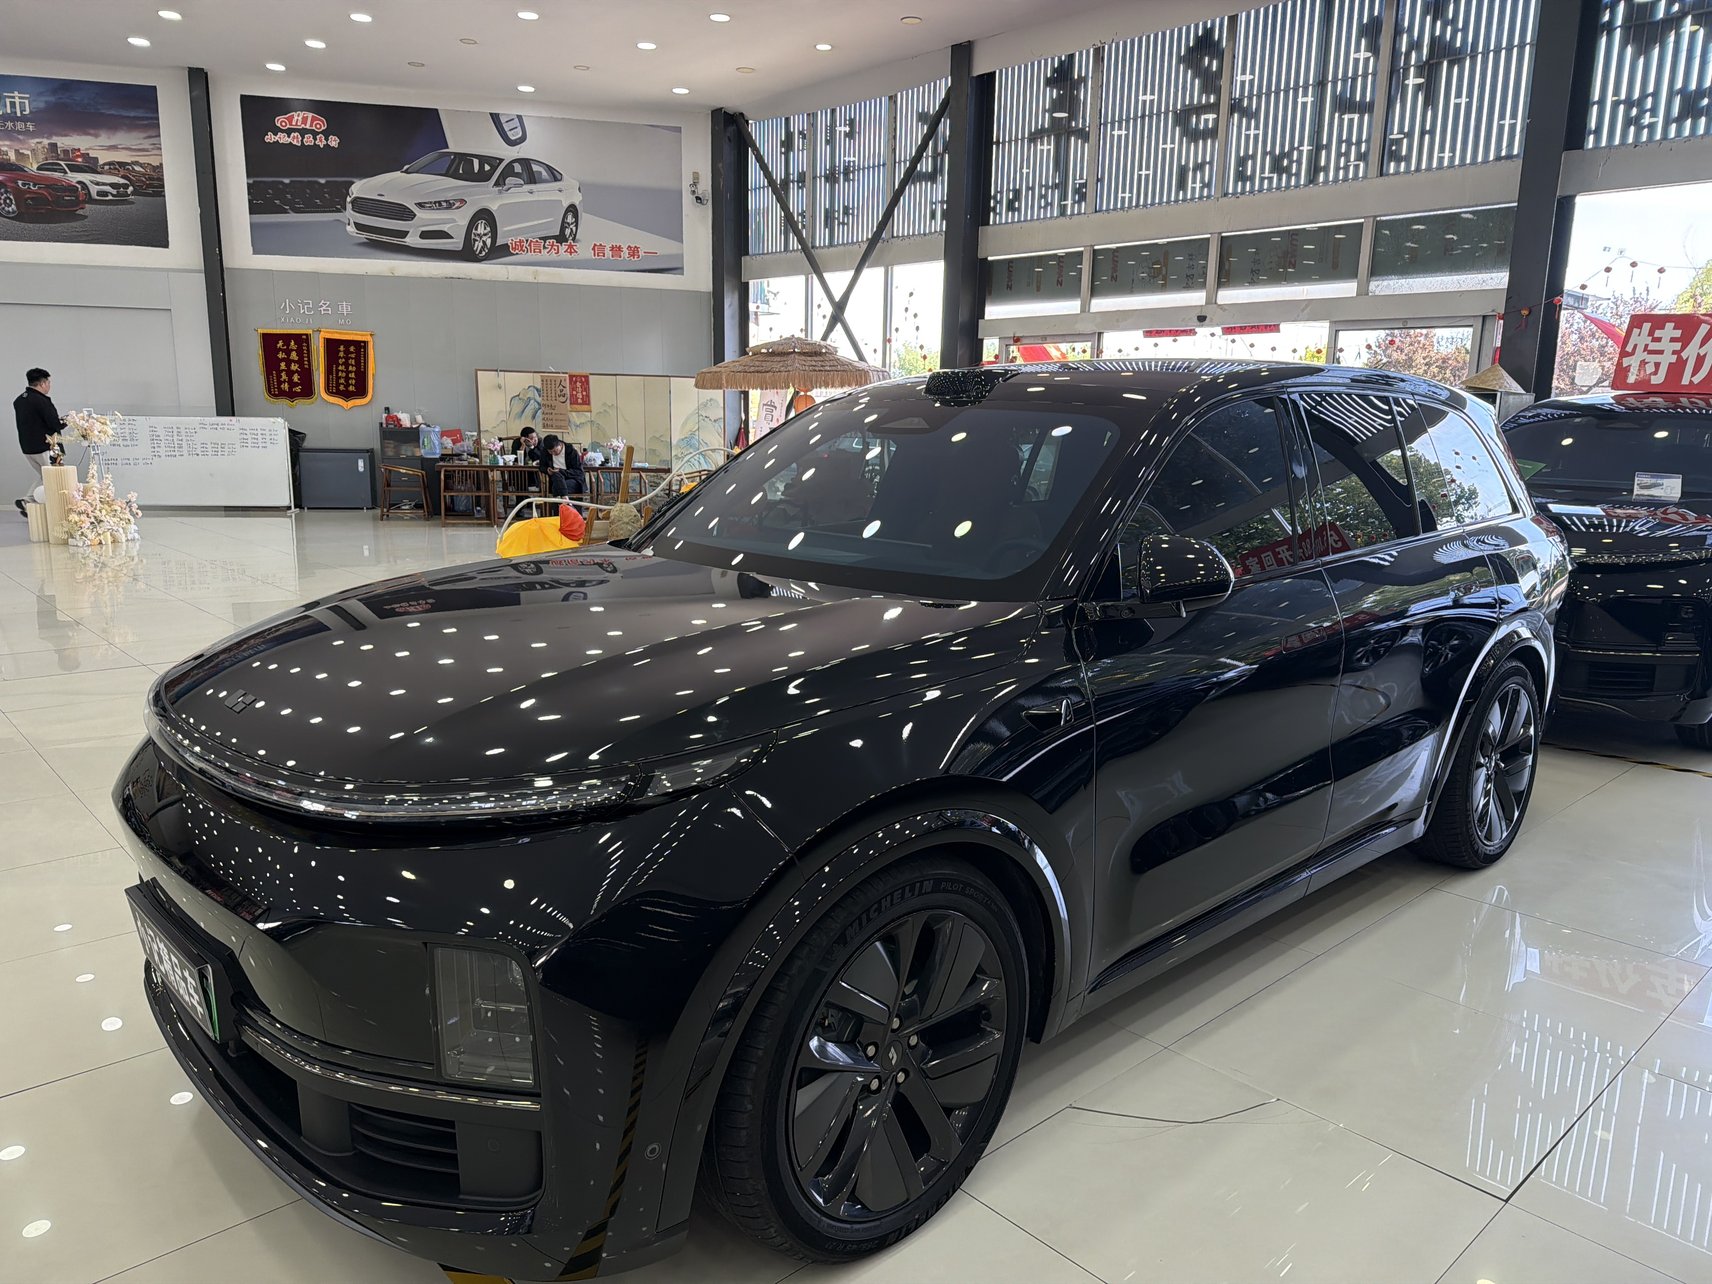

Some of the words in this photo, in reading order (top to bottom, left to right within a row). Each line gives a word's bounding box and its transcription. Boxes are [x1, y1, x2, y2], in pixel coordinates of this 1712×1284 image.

[0, 91, 30, 117] 市
[264, 131, 340, 148] 小记精品车行
[508, 238, 579, 257] 诚信为本
[591, 242, 659, 260] 信誉第一
[280, 299, 353, 316] 小记名車
[280, 316, 301, 324] XIAO
[844, 879, 934, 942] MICHELIN
[940, 880, 963, 892] PILOT
